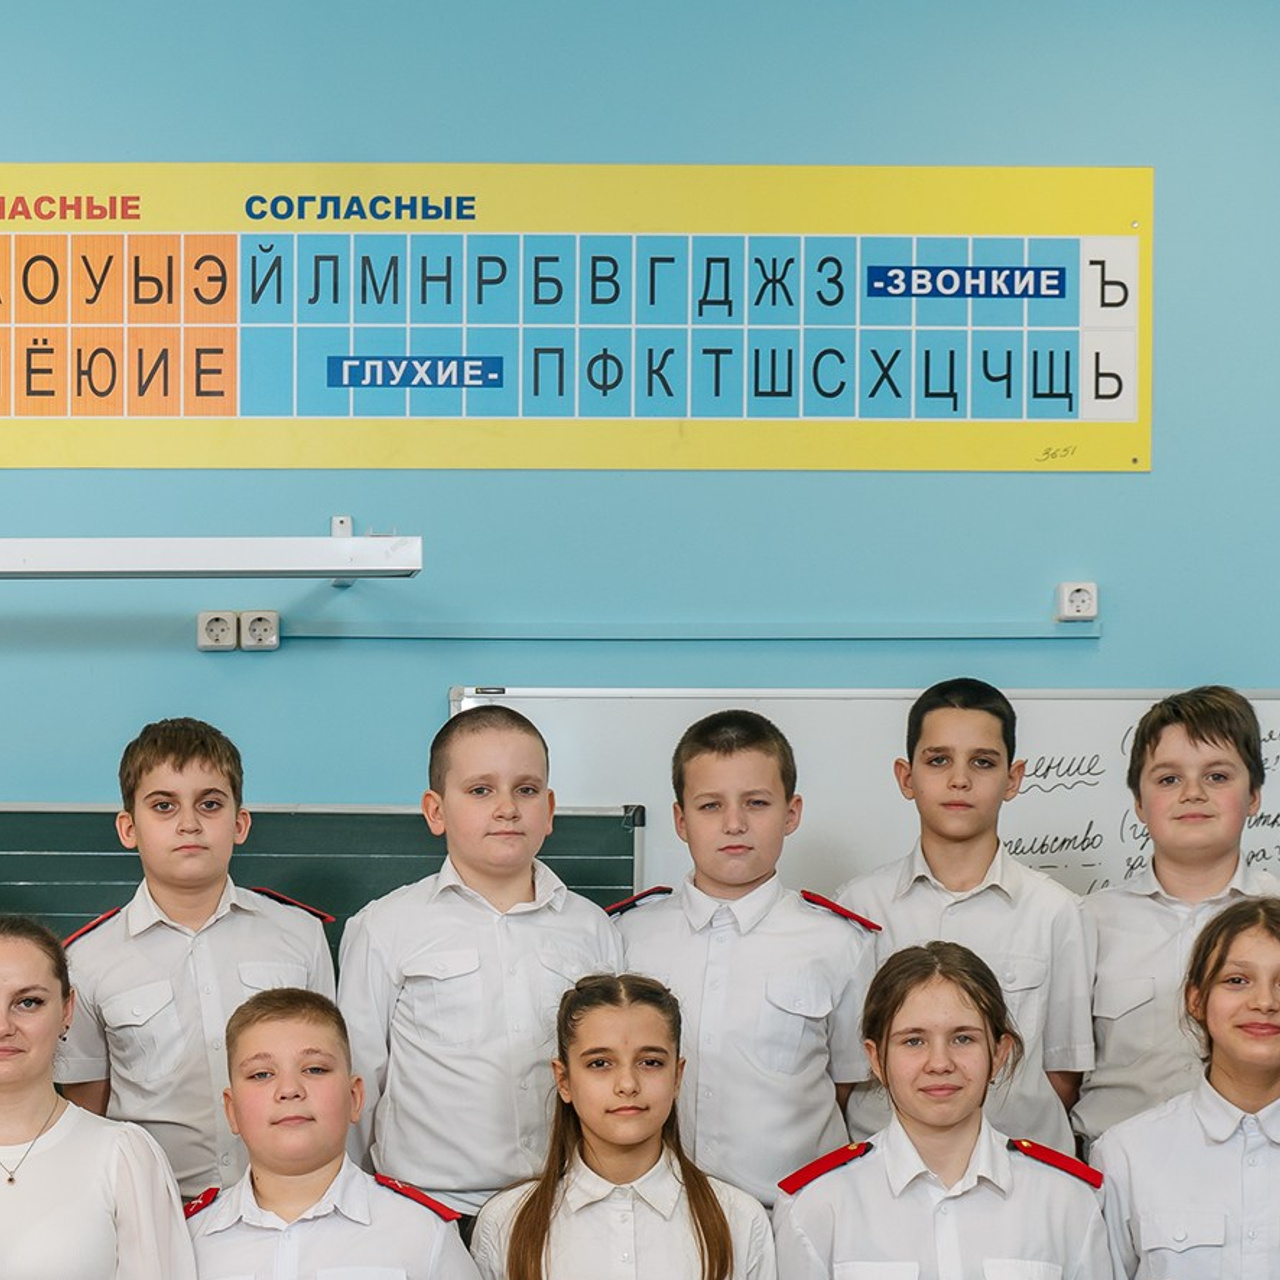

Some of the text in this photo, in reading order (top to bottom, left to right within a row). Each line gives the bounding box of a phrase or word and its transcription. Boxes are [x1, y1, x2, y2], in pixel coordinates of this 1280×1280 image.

[245, 195, 477, 220] СОГЛАСНЫЕ
[873, 269, 1061, 295] -ЗВОНКИЕ
[342, 360, 499, 385] ГЛУХИЕ-
[1023, 753, 1106, 780] ение
